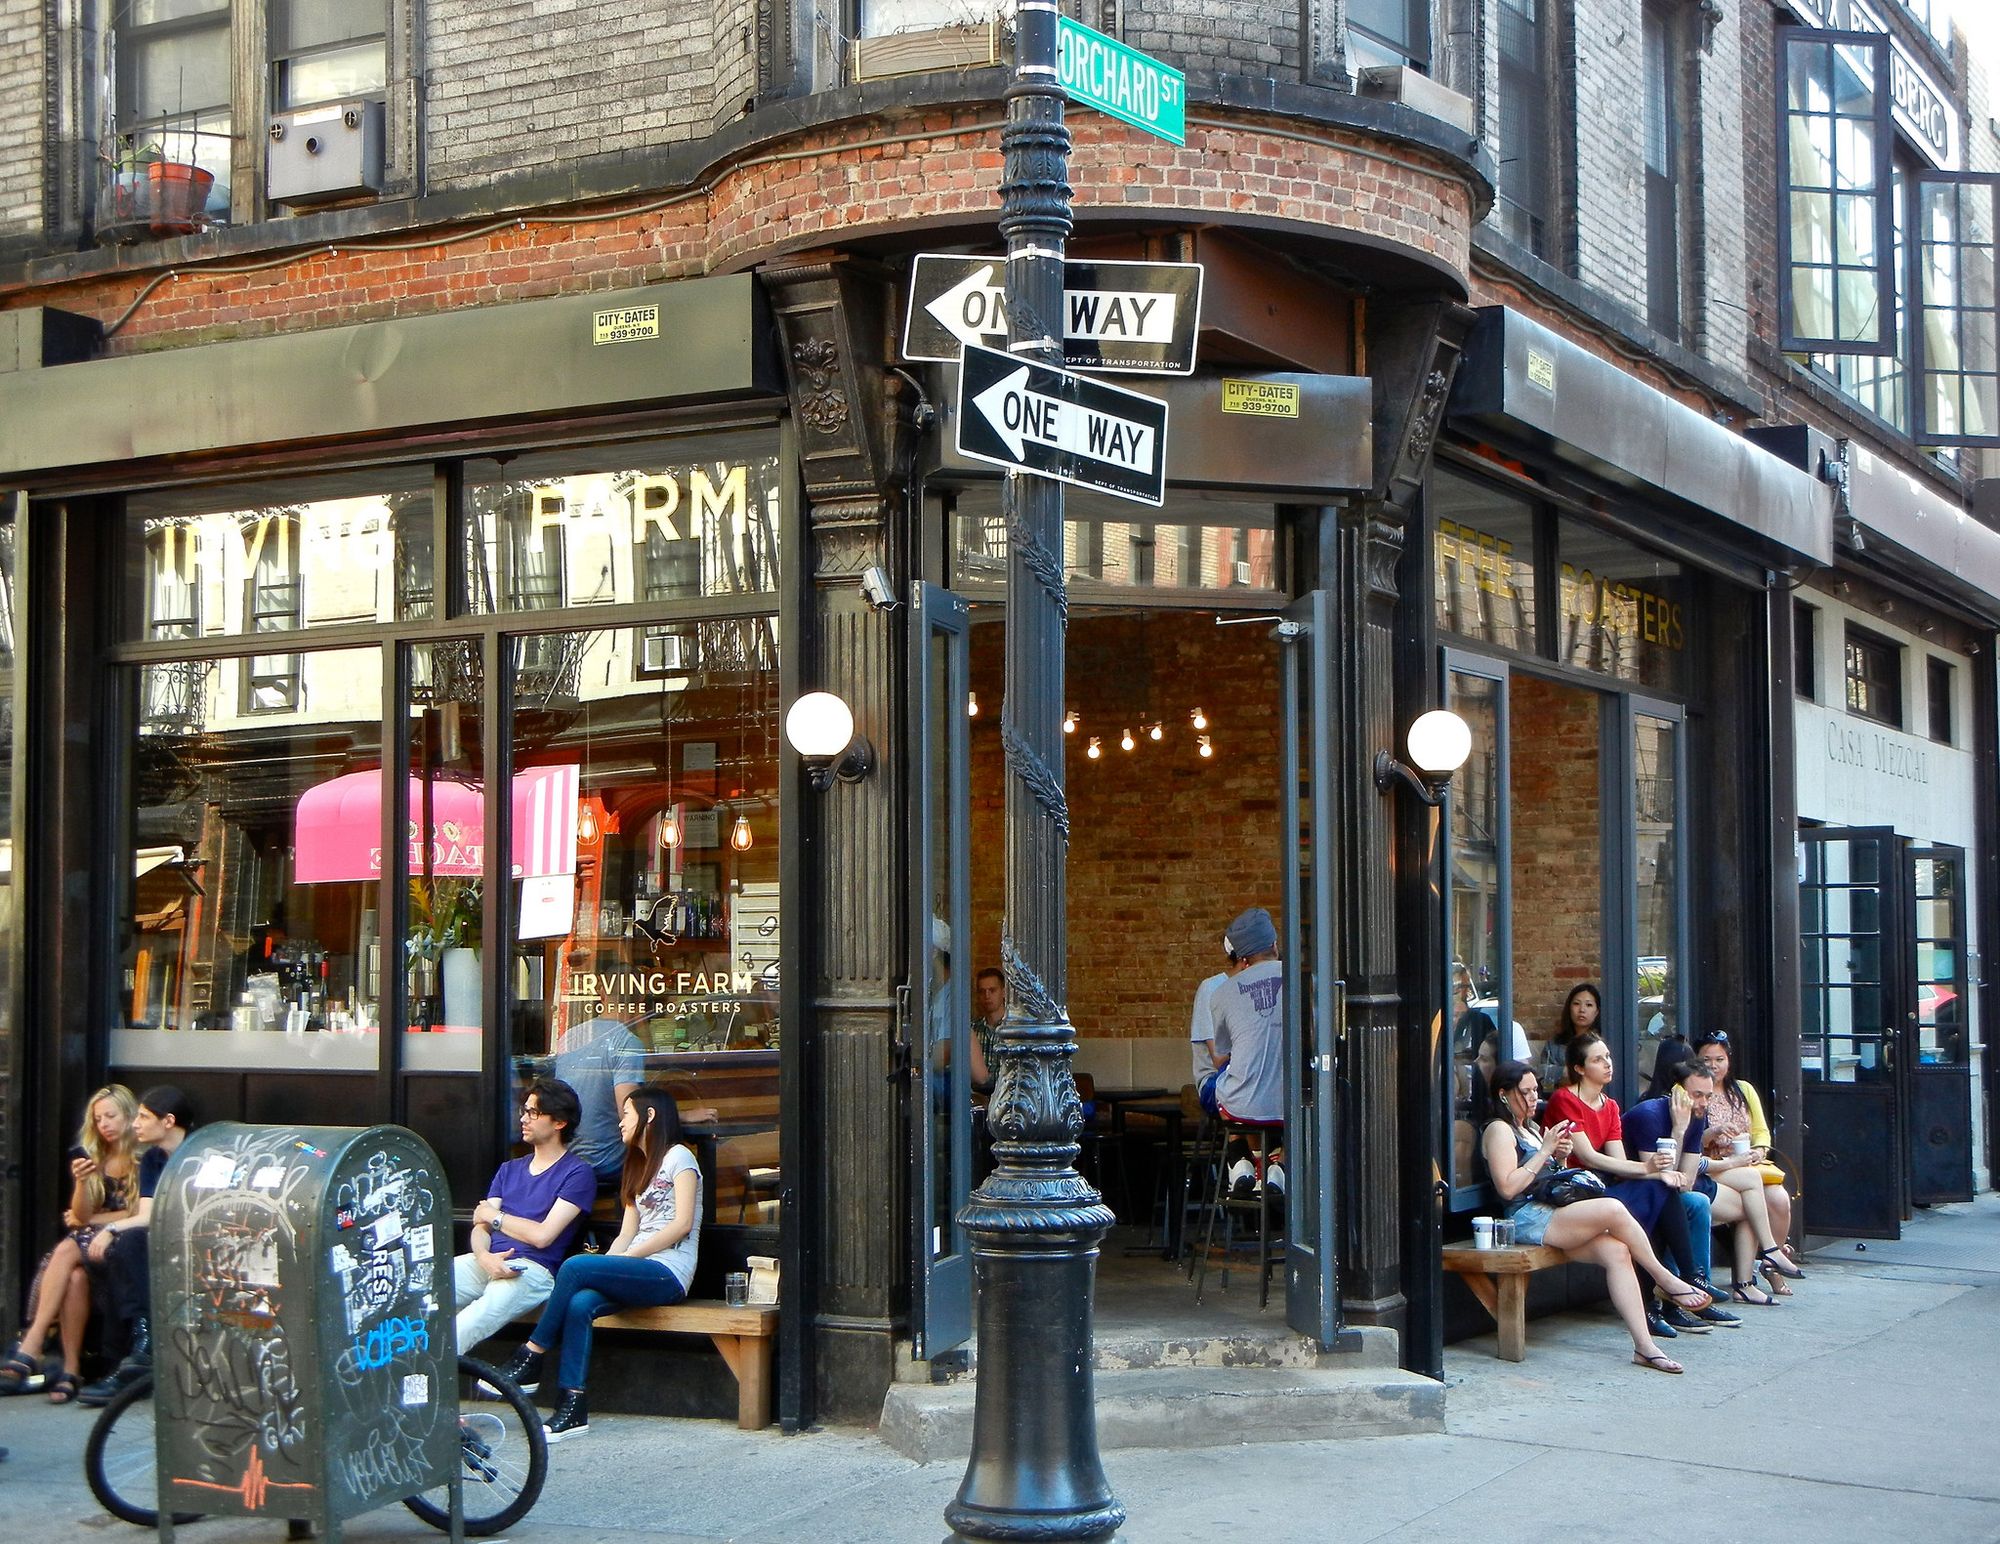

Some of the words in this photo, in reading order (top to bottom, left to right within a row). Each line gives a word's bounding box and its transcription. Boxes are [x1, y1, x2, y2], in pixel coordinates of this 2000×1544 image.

[1060, 27, 1158, 121] ORCHARD
[1161, 74, 1180, 106] ST
[598, 309, 655, 327] CITY-GATES
[962, 291, 1007, 328] ON
[1071, 295, 1156, 336] WAY
[1101, 358, 1181, 369] TRANSPORTATION
[1228, 383, 1293, 399] CITY-GATES
[1003, 390, 1059, 443] ONE
[1088, 414, 1144, 465] WAY
[1827, 721, 1864, 768] CASA
[1874, 733, 1929, 784] MEZCAL
[573, 972, 667, 996] IRVING
[677, 971, 753, 995] FARM
[584, 1002, 647, 1014] COFFEE
[655, 1001, 742, 1014] ROASTERS
[337, 1209, 353, 1225] BFA
